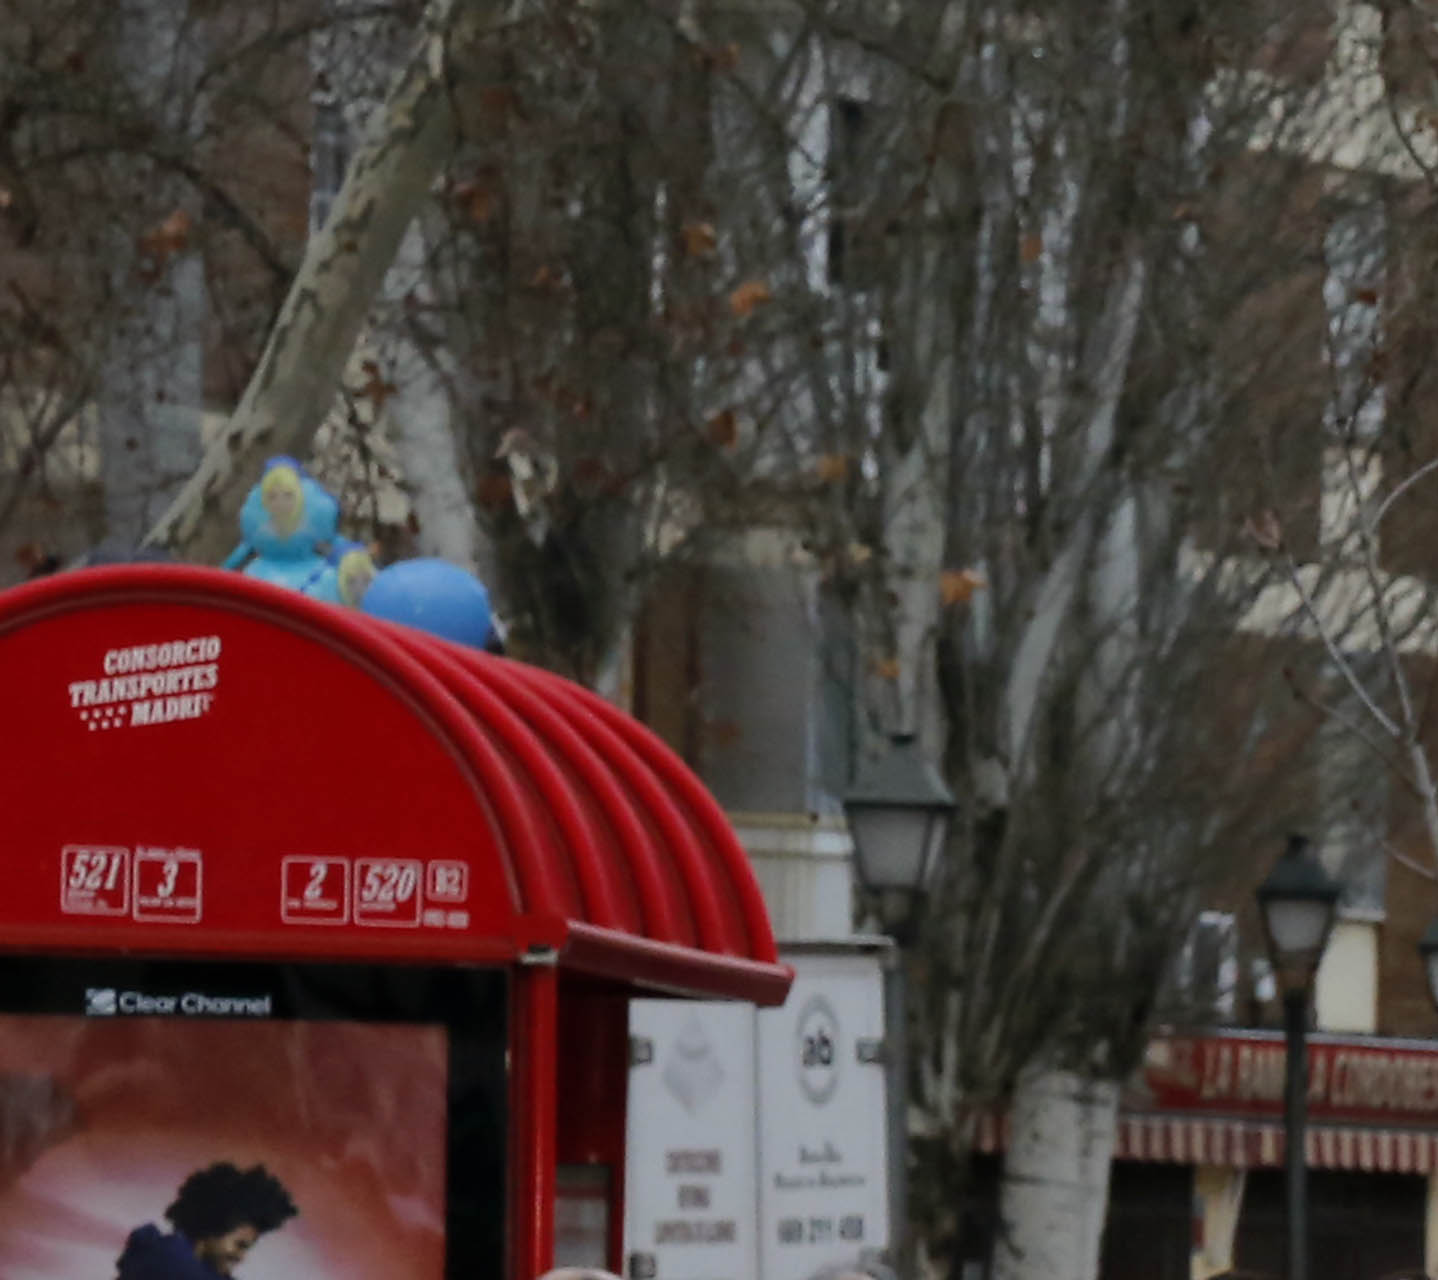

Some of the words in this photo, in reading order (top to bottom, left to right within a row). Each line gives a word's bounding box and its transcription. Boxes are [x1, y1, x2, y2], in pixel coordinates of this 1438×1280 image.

[104, 636, 221, 675] CONSORCIO
[68, 664, 219, 707] TRANSPORTES
[69, 850, 121, 890] 521
[157, 858, 179, 897] 3
[304, 862, 328, 900] 2
[361, 864, 417, 902] 520
[119, 991, 176, 1014] Clear
[181, 991, 272, 1014] Channel
